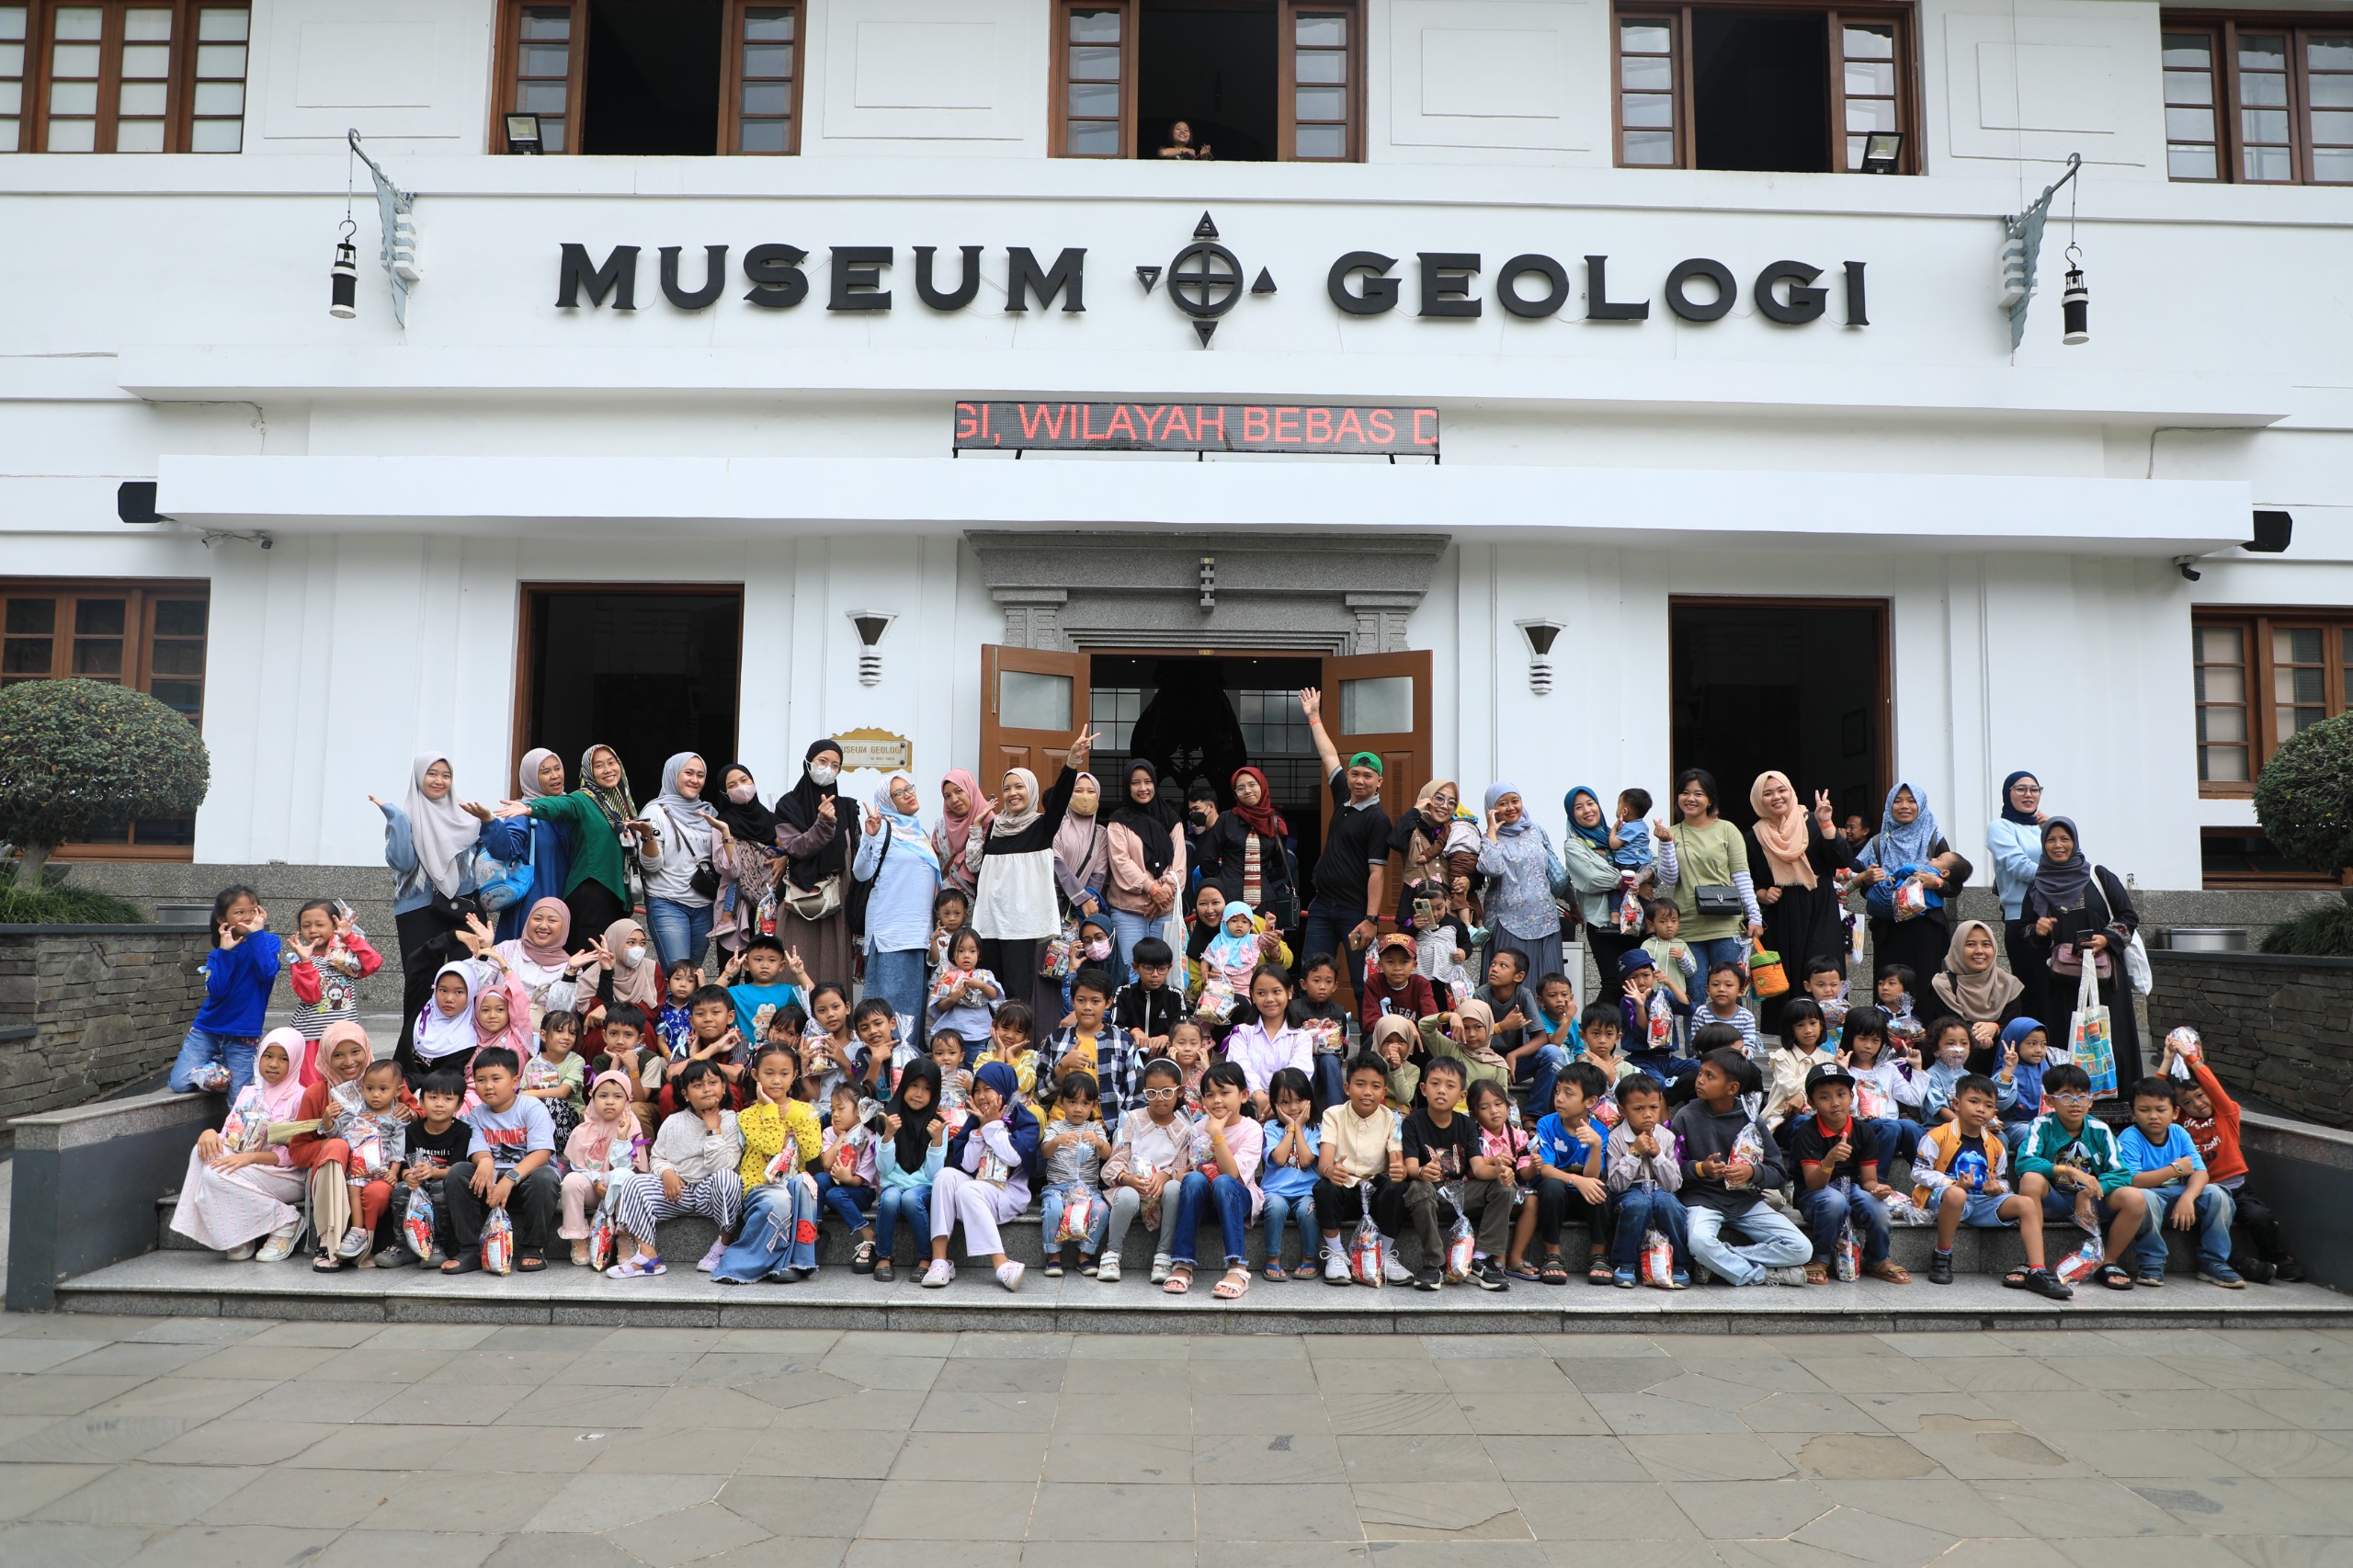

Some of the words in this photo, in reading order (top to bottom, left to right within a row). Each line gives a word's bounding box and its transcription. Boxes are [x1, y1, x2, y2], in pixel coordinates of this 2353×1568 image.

[554, 243, 1088, 313] MUSEUM
[1327, 250, 1870, 326] GEOLOGI
[1017, 403, 1224, 442] WILAYAH
[1244, 406, 1395, 444] BEBAS
[840, 745, 867, 754] USEUM
[1393, 1006, 1418, 1021] VEGA
